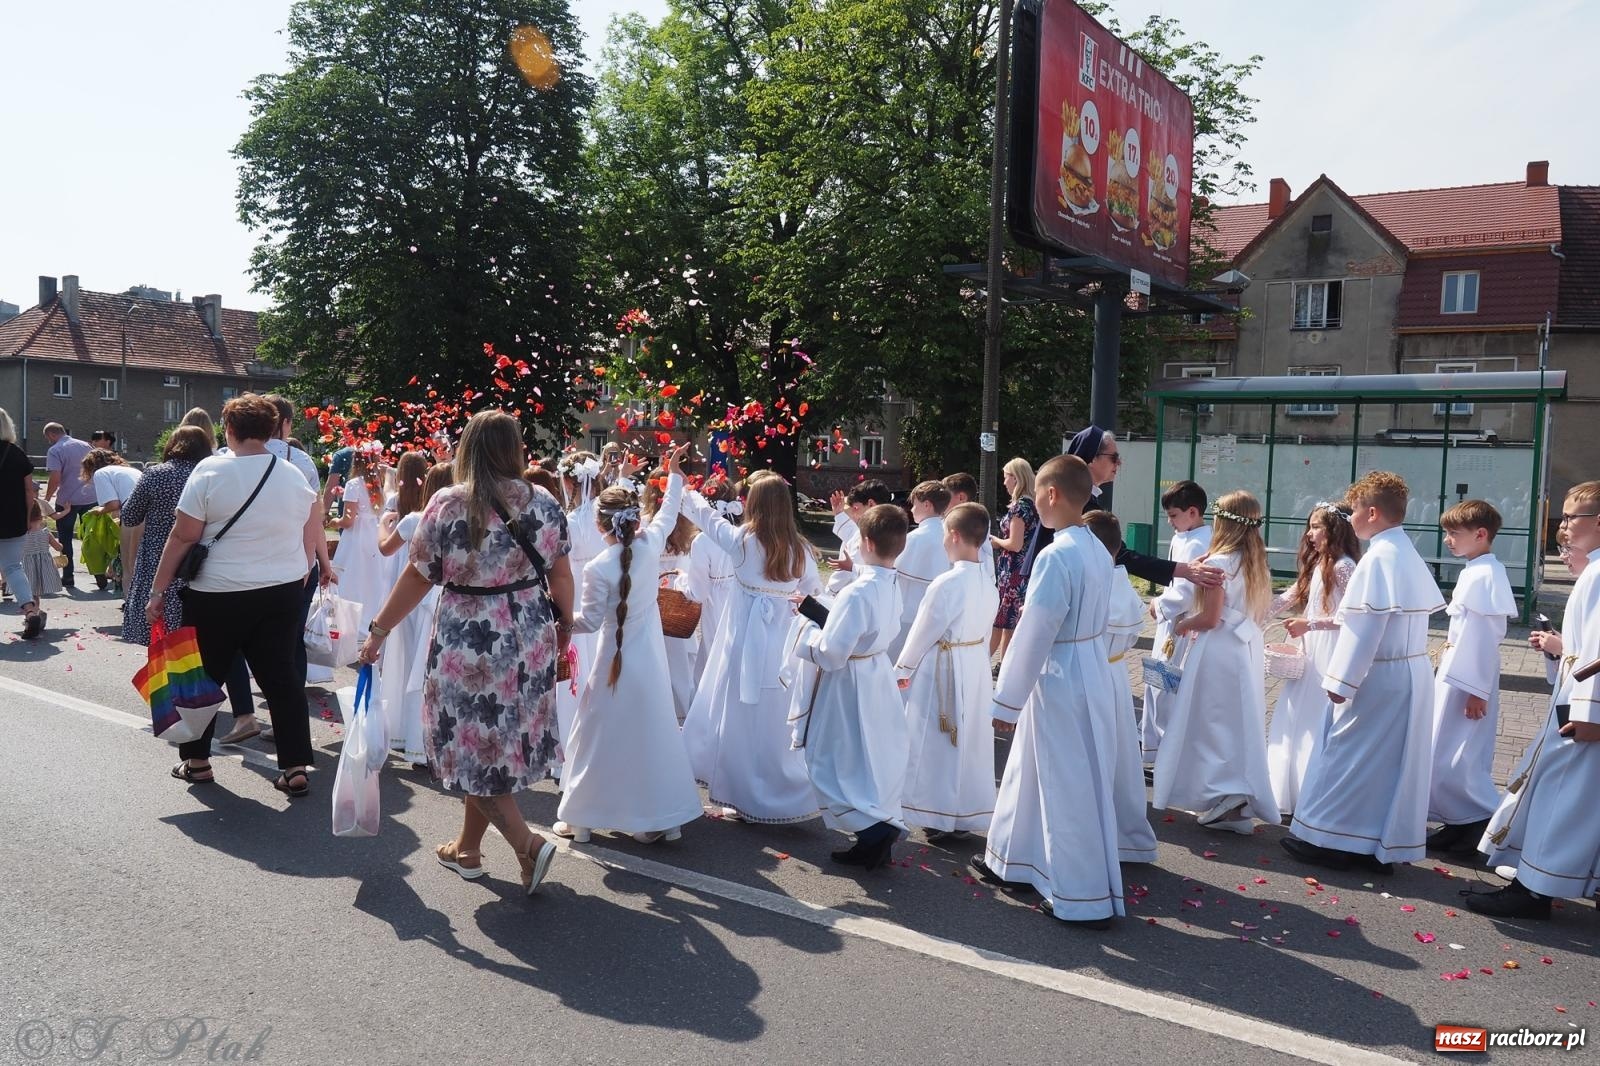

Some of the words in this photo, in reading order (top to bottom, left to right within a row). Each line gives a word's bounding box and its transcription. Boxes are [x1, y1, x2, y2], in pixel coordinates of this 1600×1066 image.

[1081, 72, 1094, 89] KFC
[1099, 58, 1137, 109] EXTRA
[1137, 87, 1161, 123] TRIO
